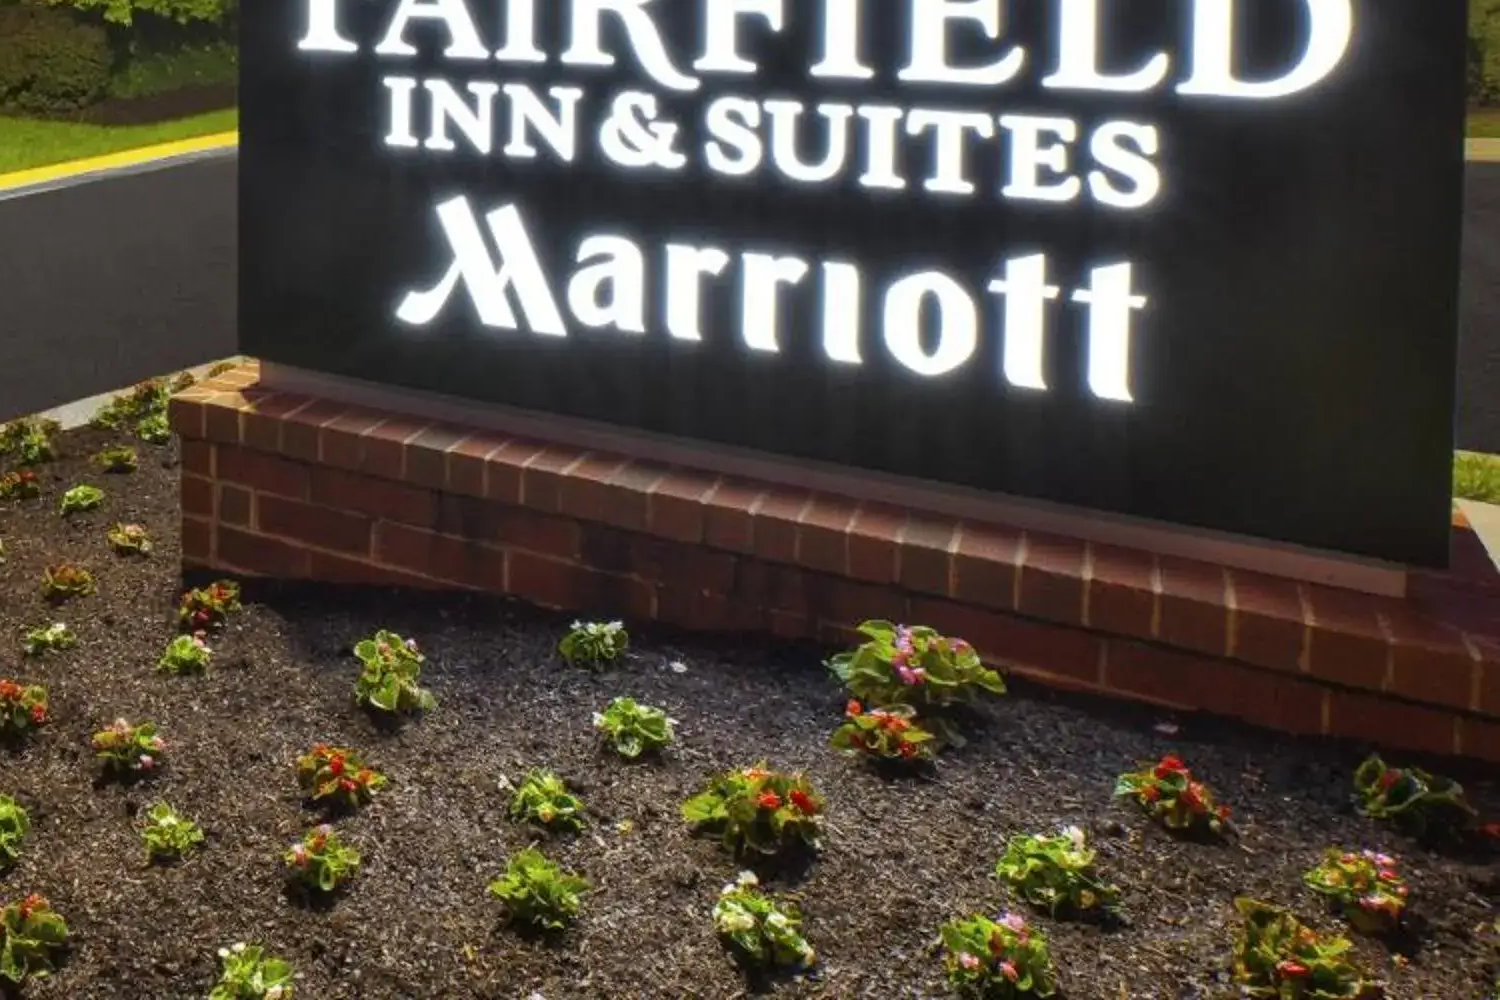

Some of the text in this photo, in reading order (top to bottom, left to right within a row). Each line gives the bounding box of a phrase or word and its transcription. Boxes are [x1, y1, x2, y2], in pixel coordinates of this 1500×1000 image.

[383, 76, 1161, 209] INN & SUITES
[395, 195, 1148, 403] Marriott
